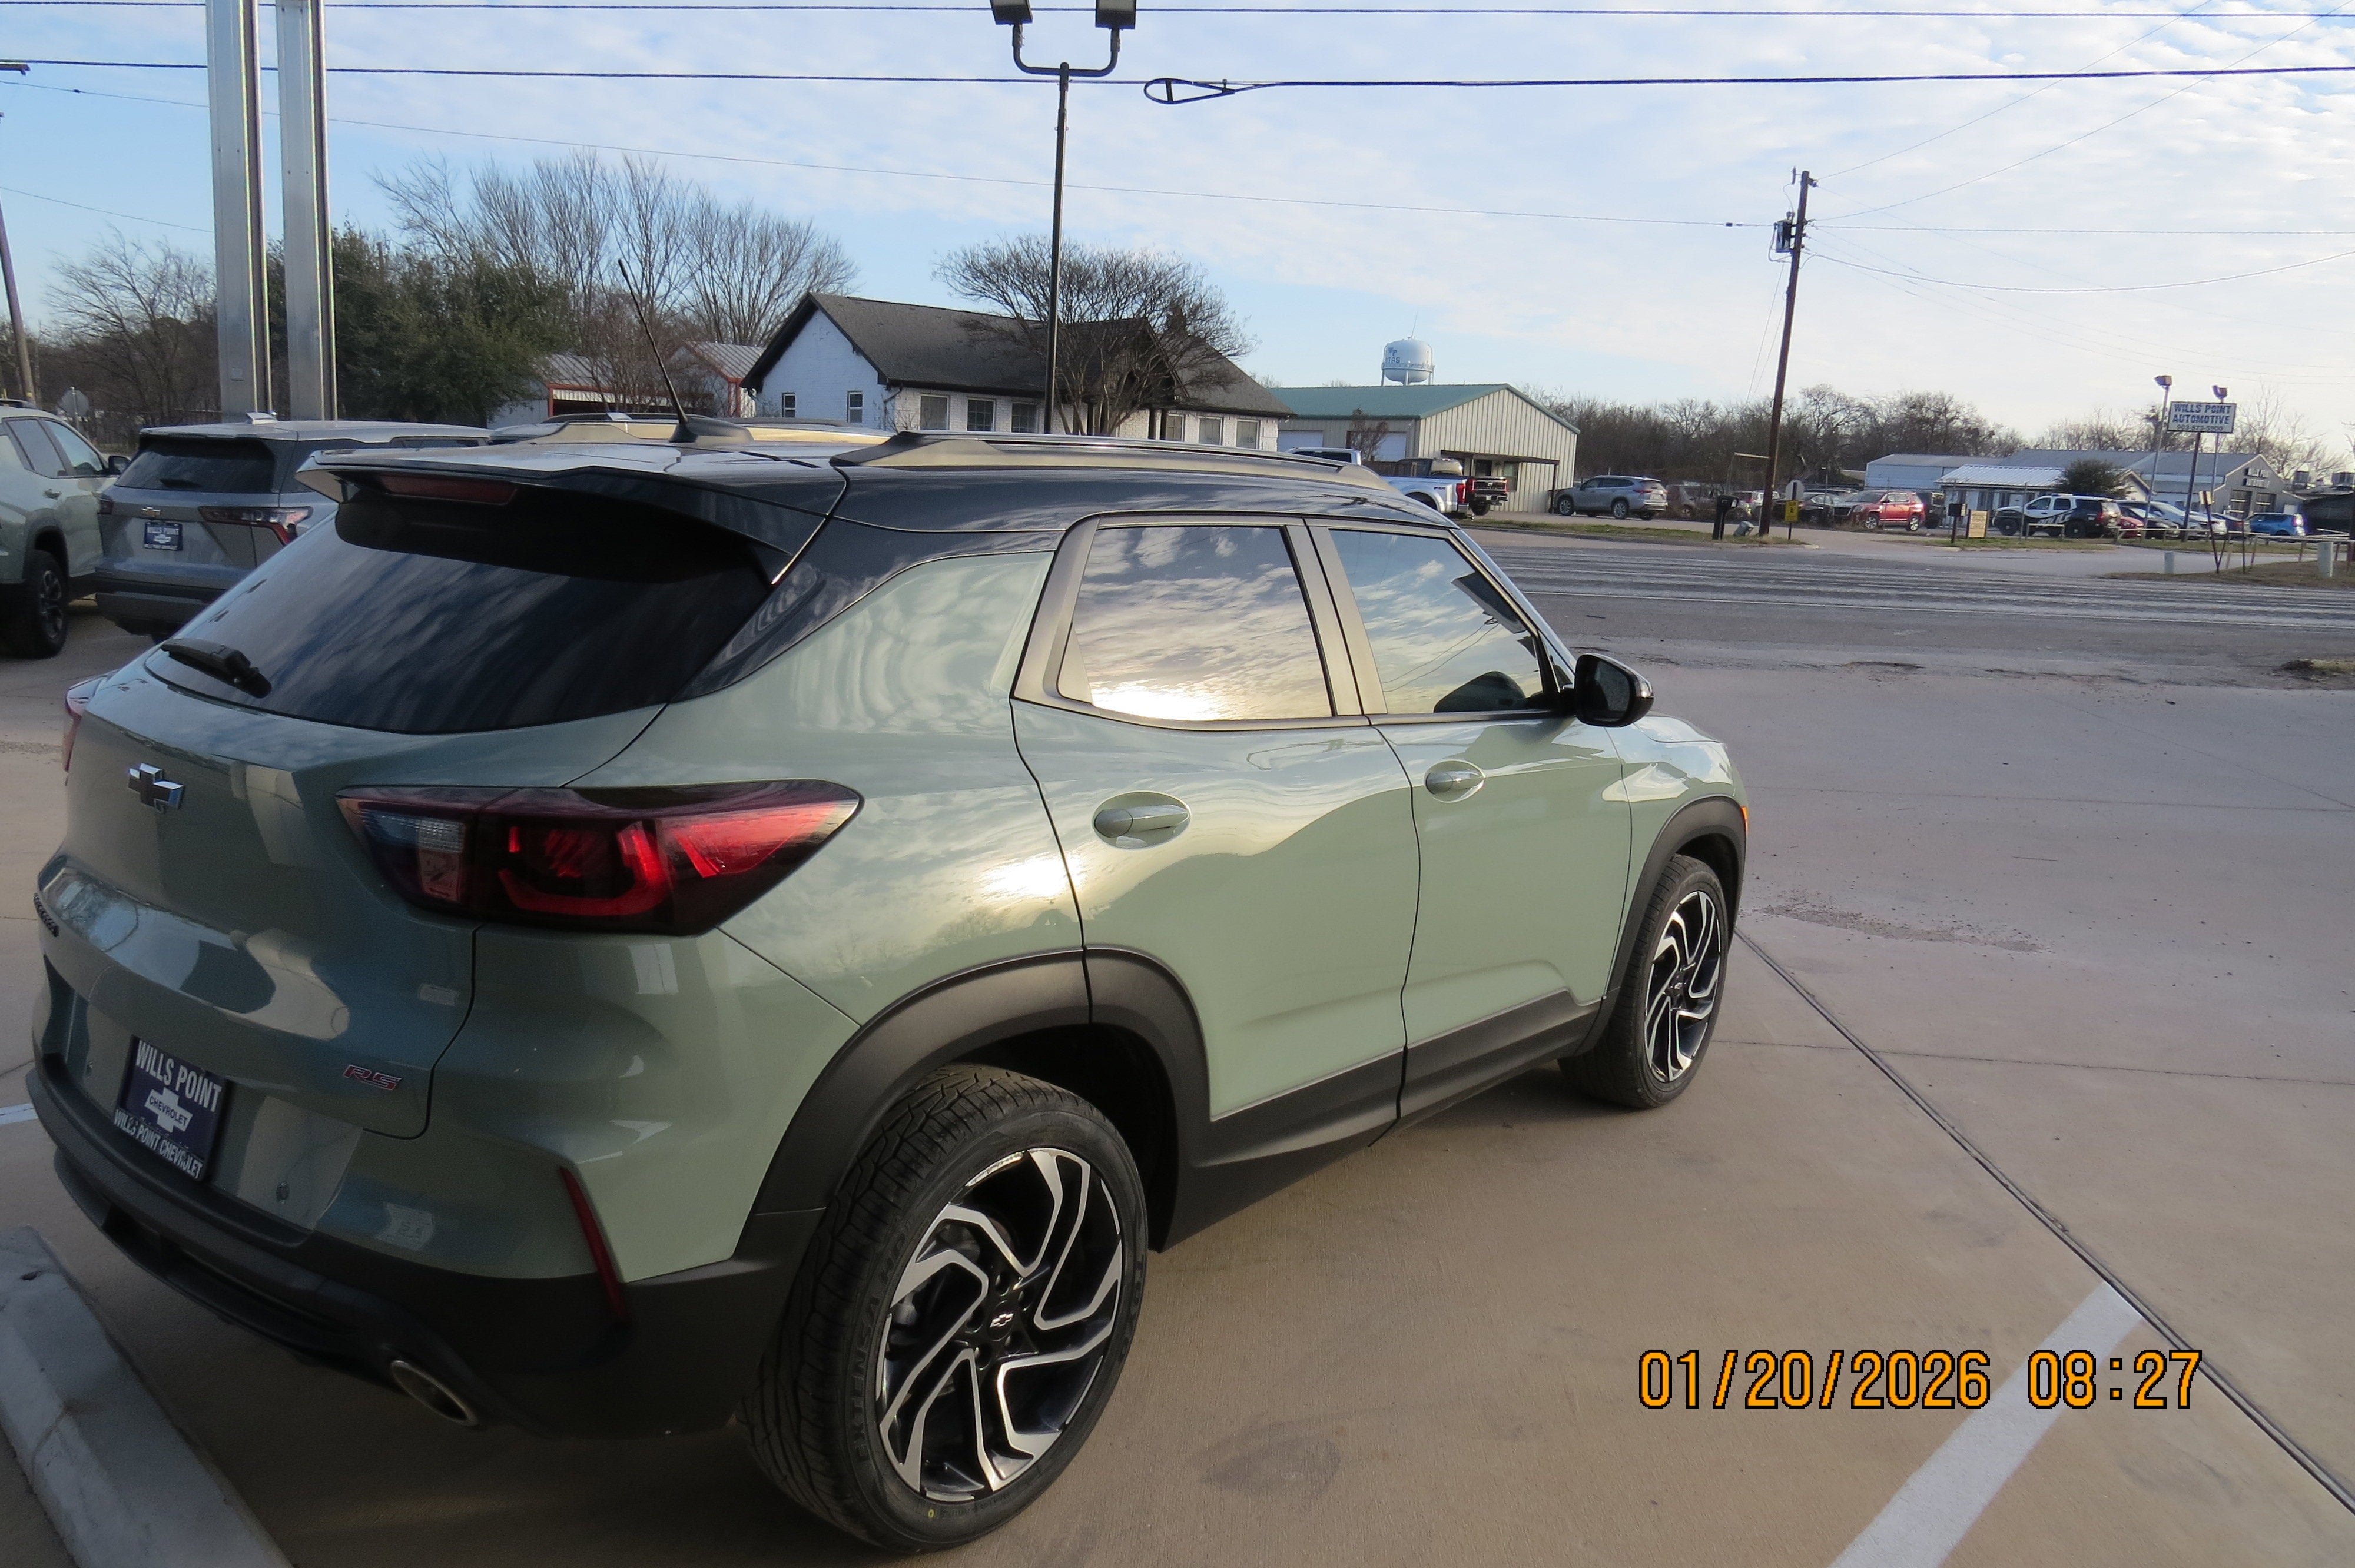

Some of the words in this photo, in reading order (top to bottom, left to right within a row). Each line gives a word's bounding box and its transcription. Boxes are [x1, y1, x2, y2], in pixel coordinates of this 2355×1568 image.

[2172, 414, 2230, 424] AUTOMOTIVE
[2174, 404, 2202, 413] WILLS
[2204, 404, 2231, 414] POINT
[136, 1039, 174, 1086] WILLS
[175, 1064, 222, 1112] POINT
[343, 1064, 402, 1091] RS
[149, 1095, 188, 1125] CHEVROLET
[114, 1109, 137, 1137] WILLS
[136, 1124, 161, 1151] POINT
